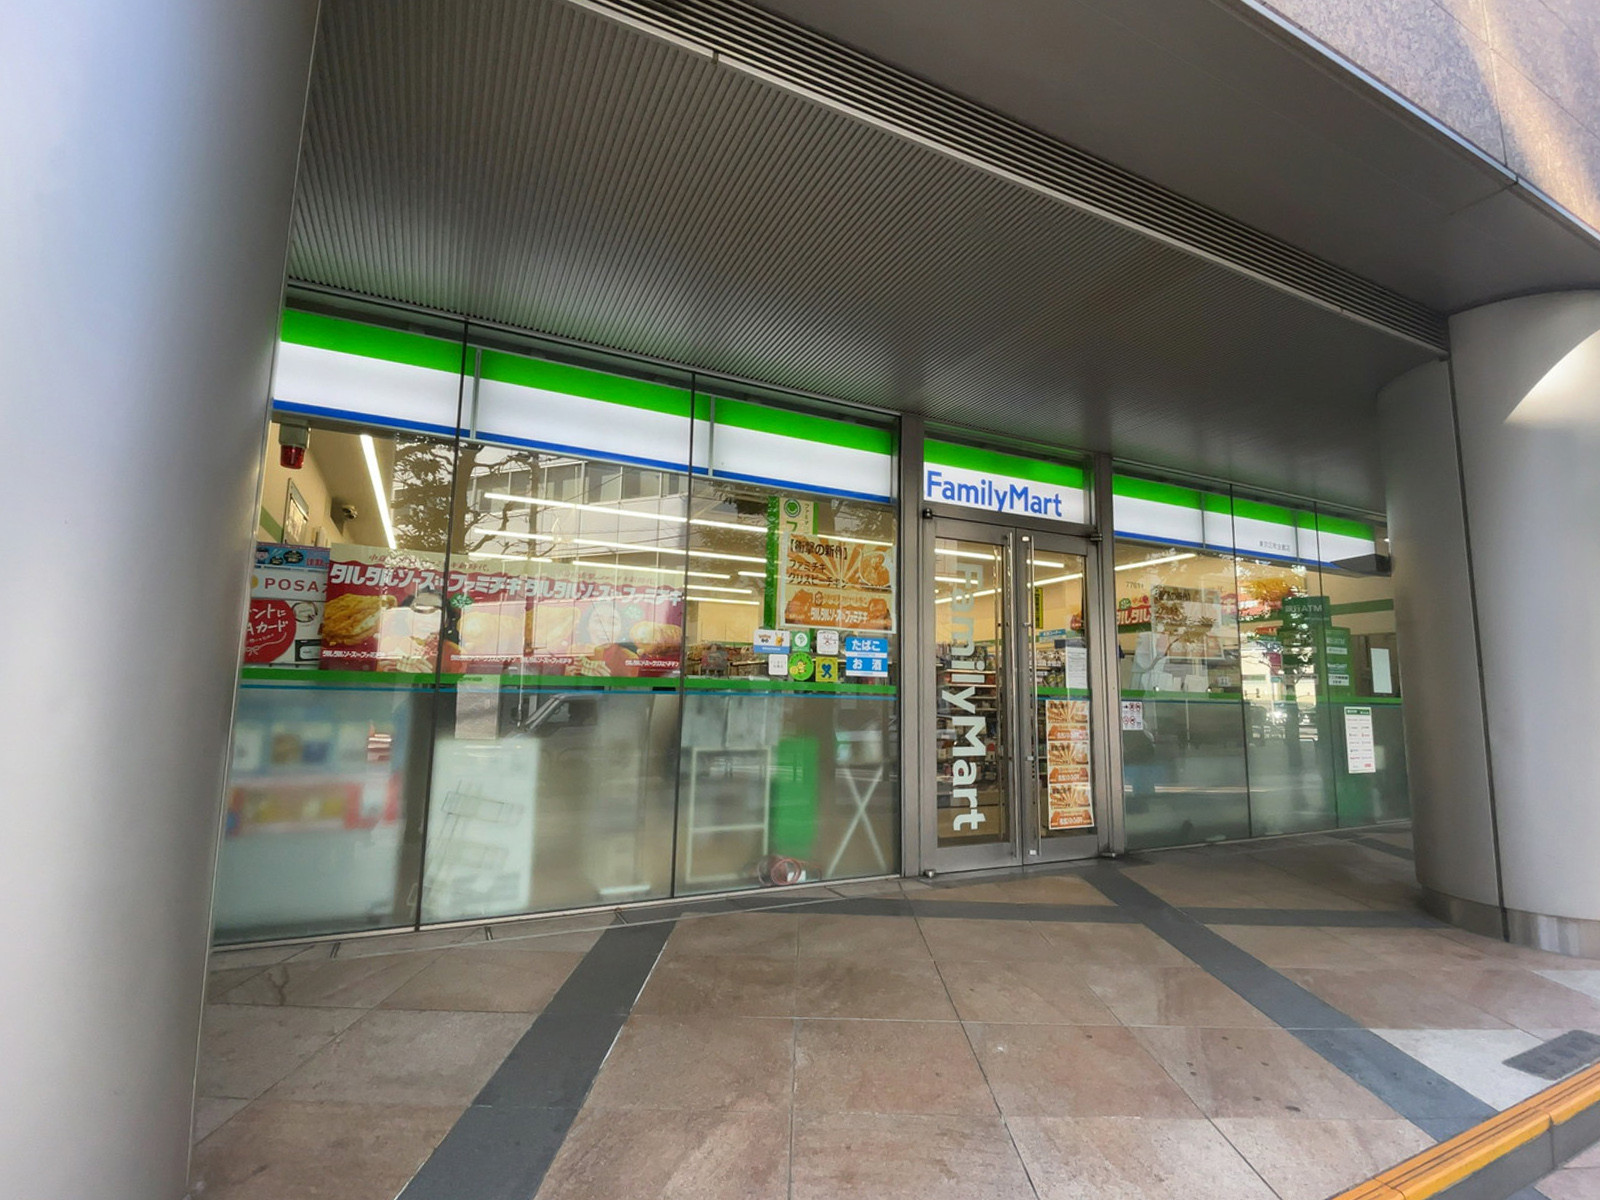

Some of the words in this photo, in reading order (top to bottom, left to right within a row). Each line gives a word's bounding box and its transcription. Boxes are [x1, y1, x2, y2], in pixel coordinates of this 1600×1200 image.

[926, 470, 1062, 517] FamilyMart
[248, 603, 287, 619] ントに
[851, 638, 880, 651] たばこ
[941, 563, 987, 831] FamilyMart
